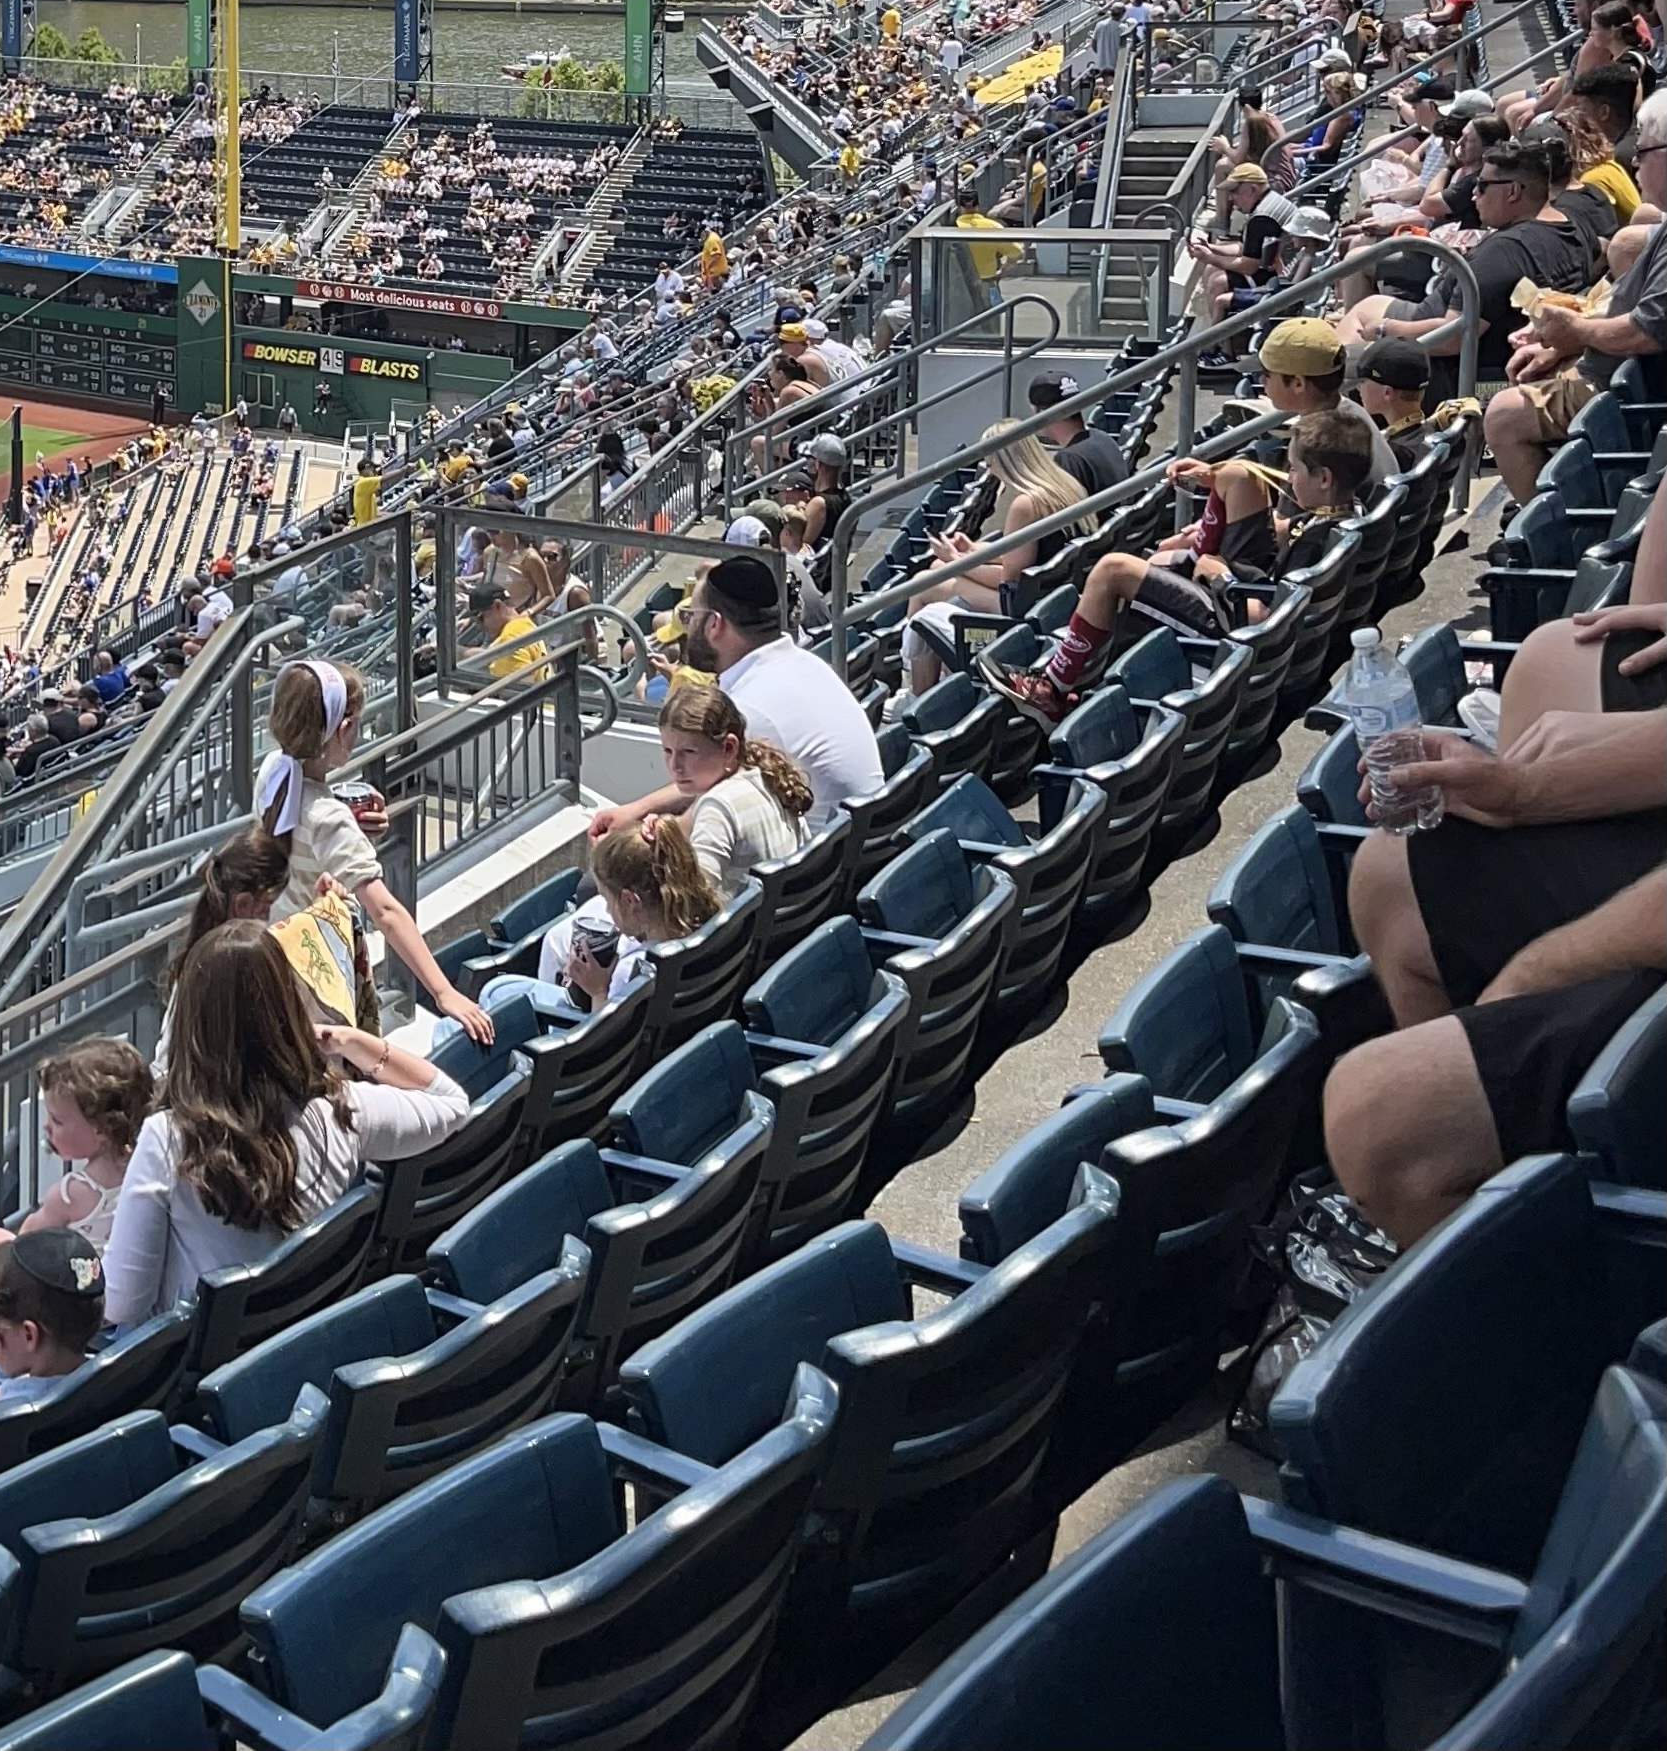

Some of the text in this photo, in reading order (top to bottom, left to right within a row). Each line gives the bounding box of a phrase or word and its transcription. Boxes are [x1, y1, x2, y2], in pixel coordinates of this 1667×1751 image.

[194, 15, 202, 41] AHN
[632, 34, 643, 62] AHN
[350, 287, 455, 312] Most delicious seats
[254, 345, 316, 366] BOWSER
[321, 349, 344, 368] 49
[360, 358, 420, 380] BLASTS
